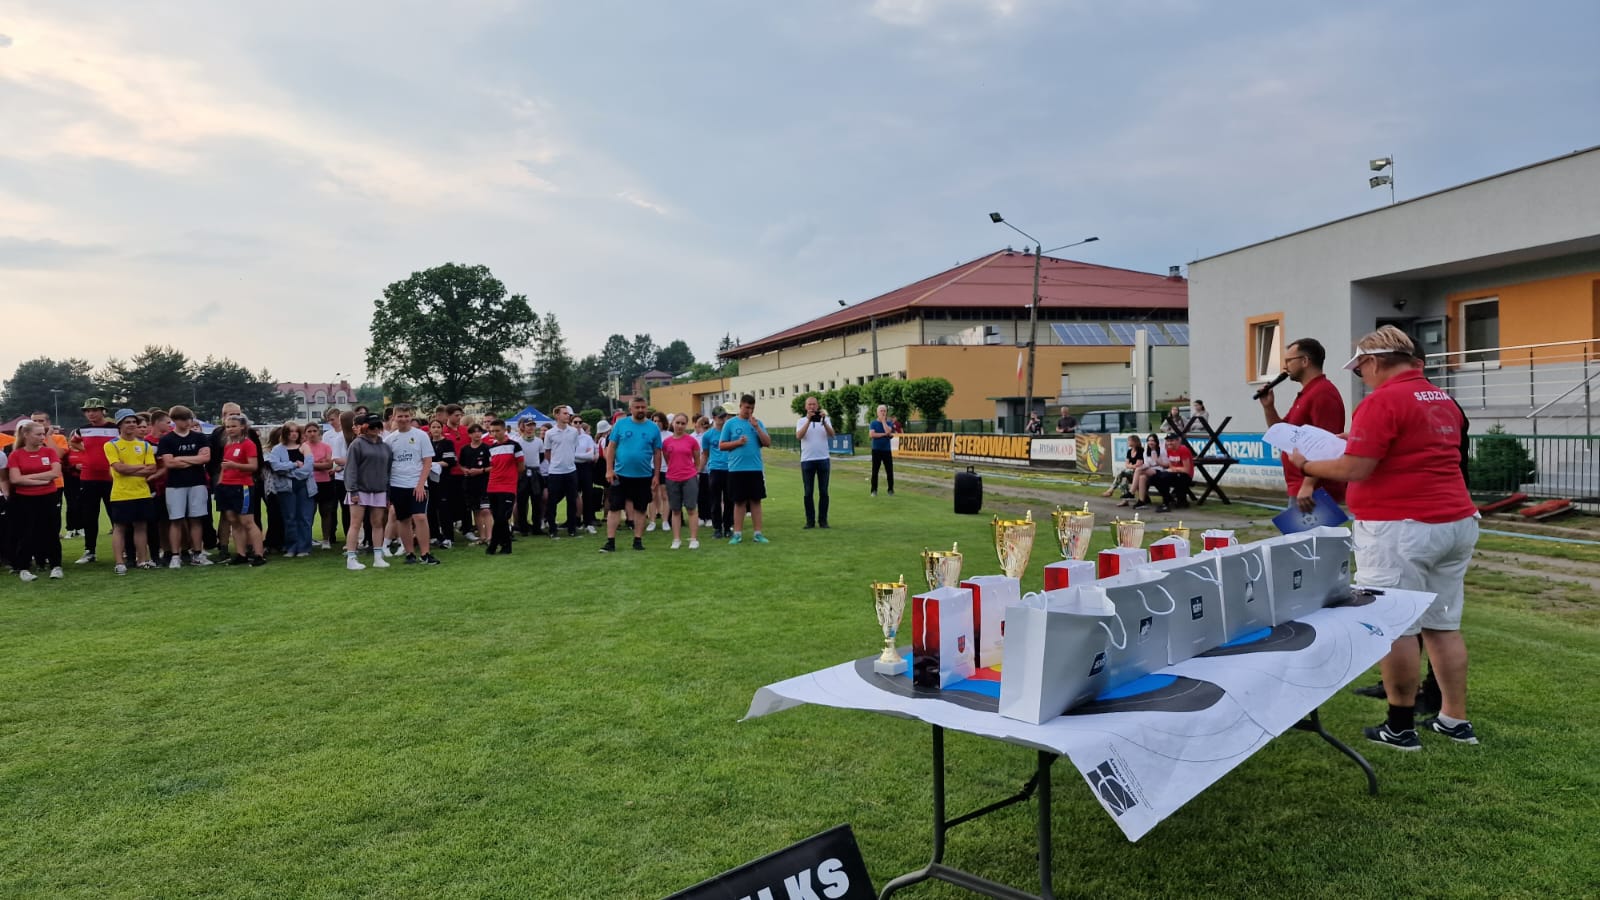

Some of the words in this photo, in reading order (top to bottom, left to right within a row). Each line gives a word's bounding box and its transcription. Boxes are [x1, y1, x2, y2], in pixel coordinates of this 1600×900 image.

[898, 435, 952, 452] PRZEWIERTY
[955, 435, 1030, 459] STEROWANE
[1224, 441, 1264, 459] DRZWI
